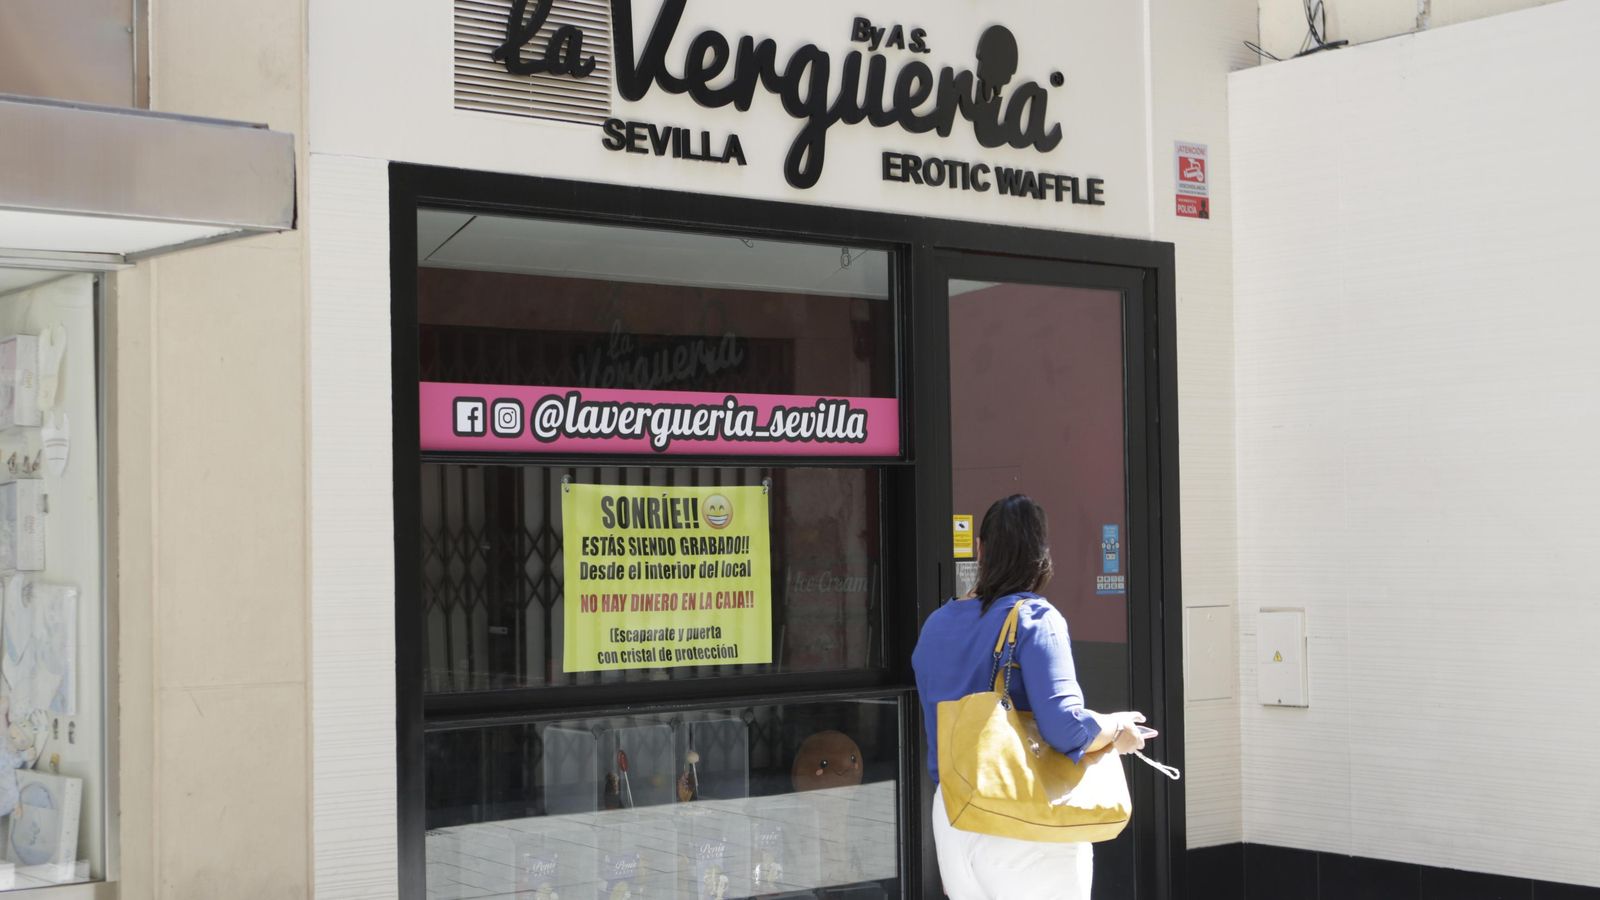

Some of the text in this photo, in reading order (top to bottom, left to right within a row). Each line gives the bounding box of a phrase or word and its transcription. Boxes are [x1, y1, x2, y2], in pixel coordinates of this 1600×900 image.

[602, 118, 747, 166] SEVILLA
[882, 151, 1105, 206] EROTIC WAFFLE
[533, 394, 867, 450] @lavergueria_sevilla
[601, 492, 700, 530] SONRÍE!!
[581, 533, 750, 557] ESTÁS SIENDO GRABADO!!
[580, 559, 752, 580] Desde el interior del local
[581, 591, 755, 614] NO HAY DINERO EN LA CAJA!!
[678, 629, 684, 642] y
[686, 625, 722, 642] puerta
[597, 650, 618, 664] con
[621, 647, 657, 664] cristal
[659, 646, 673, 662] de
